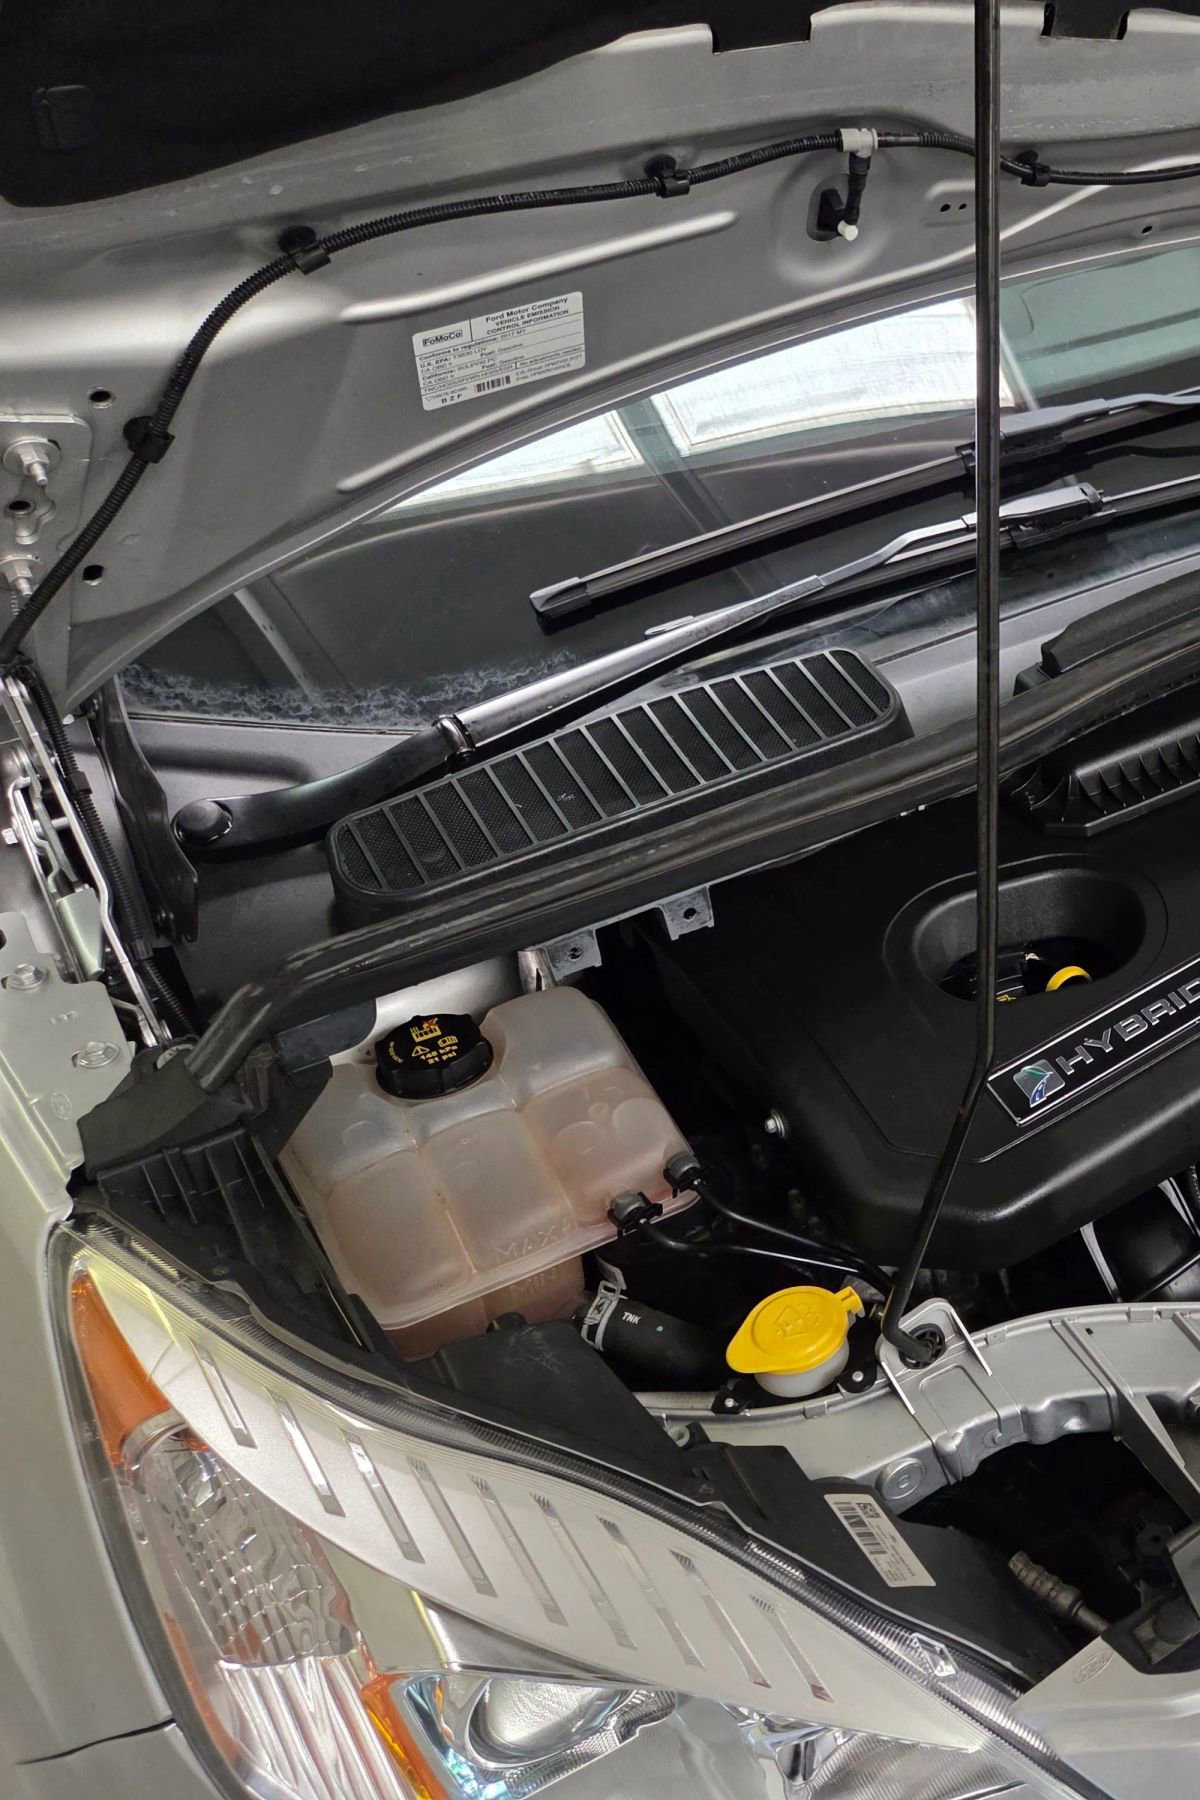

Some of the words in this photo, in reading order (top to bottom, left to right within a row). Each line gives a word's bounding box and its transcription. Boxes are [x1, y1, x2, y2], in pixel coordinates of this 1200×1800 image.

[486, 313, 504, 323] Ford
[507, 306, 528, 317] Motor
[531, 296, 567, 311] Company
[496, 315, 524, 326] VEHICLE
[527, 305, 559, 317] EMISSION
[487, 322, 519, 334] CONTROL
[522, 309, 568, 325] INFORMATION
[423, 330, 461, 346] FoMoCo
[419, 349, 451, 360] Conforms
